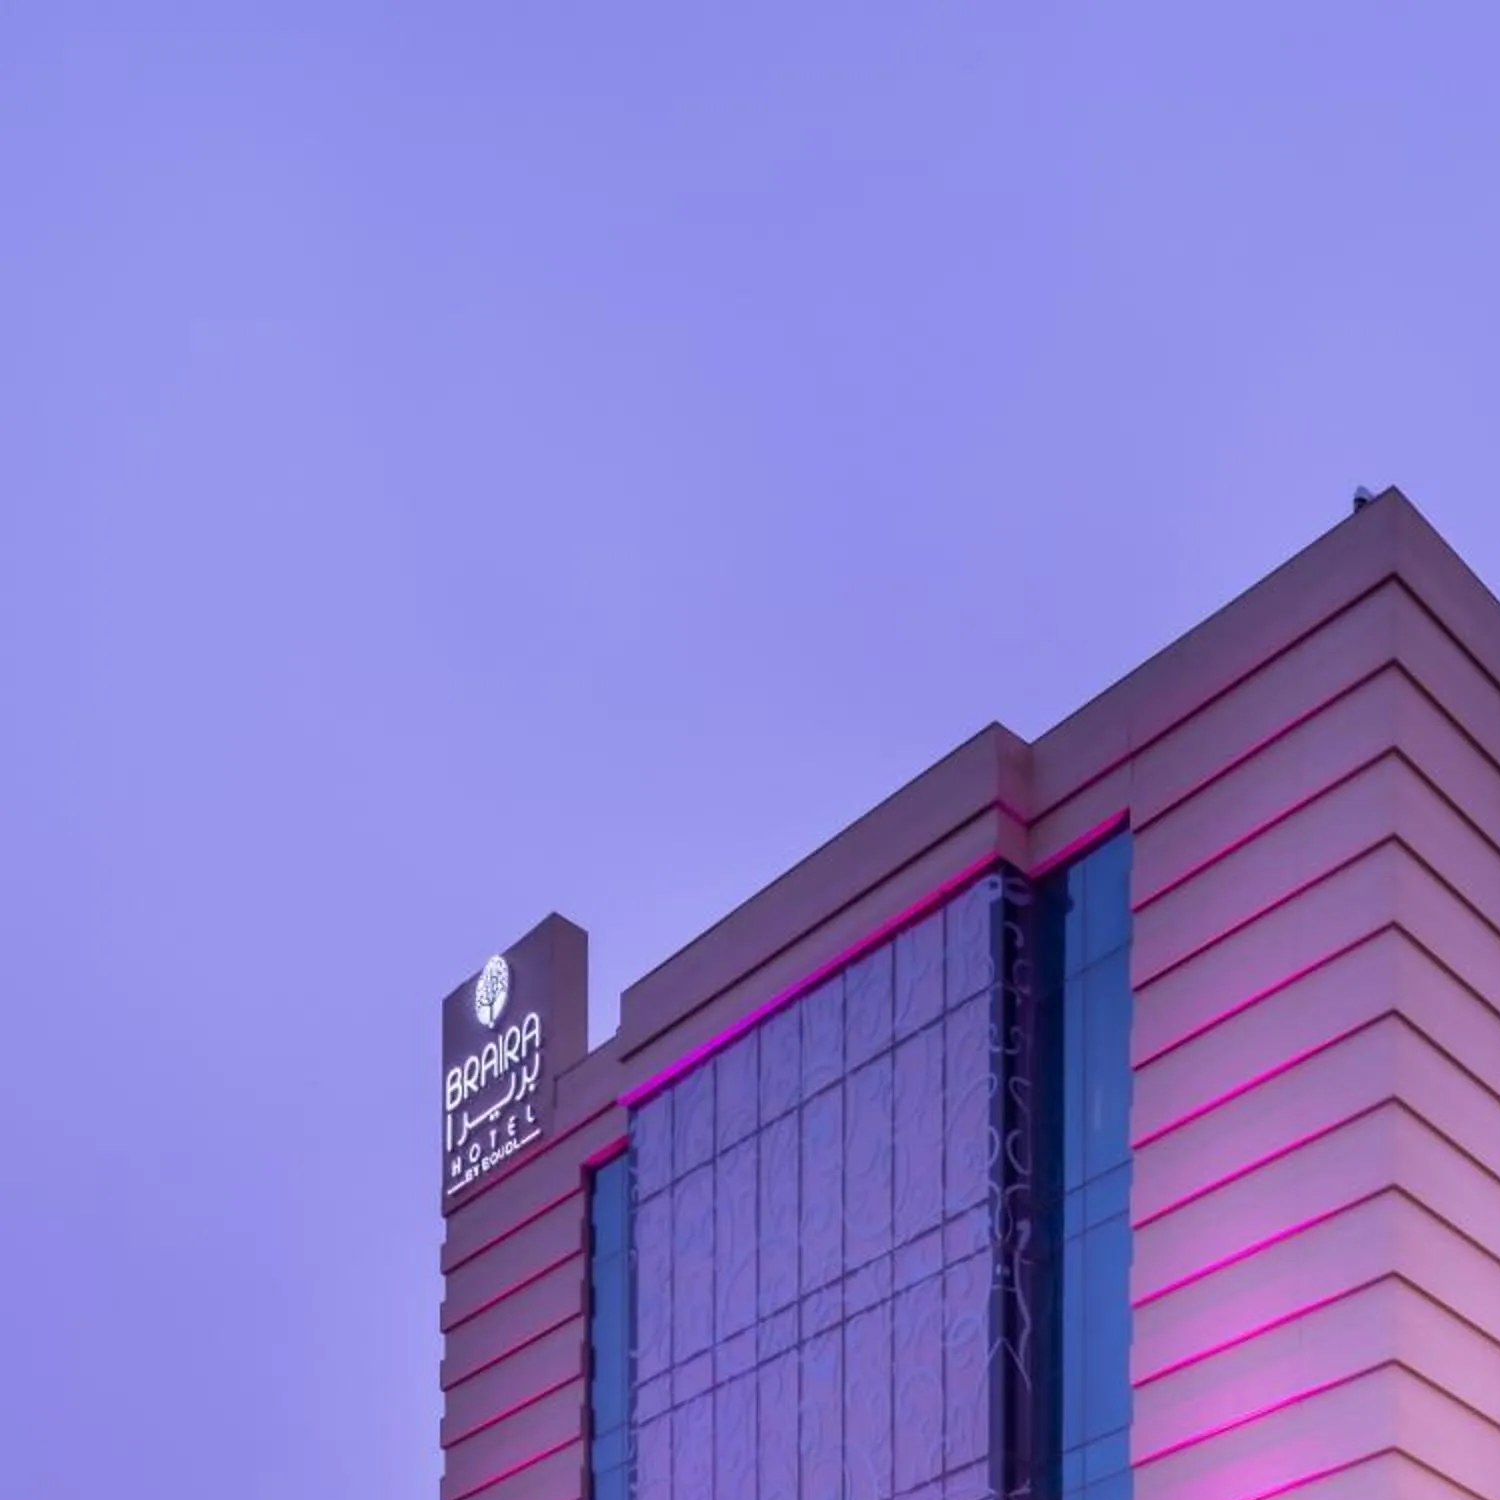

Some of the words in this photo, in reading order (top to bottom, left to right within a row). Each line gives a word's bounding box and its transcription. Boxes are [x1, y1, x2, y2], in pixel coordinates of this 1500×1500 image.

[446, 1012, 540, 1111] BRAIRA
[446, 1052, 540, 1152] بريرا
[451, 1104, 535, 1177] HOTEL
